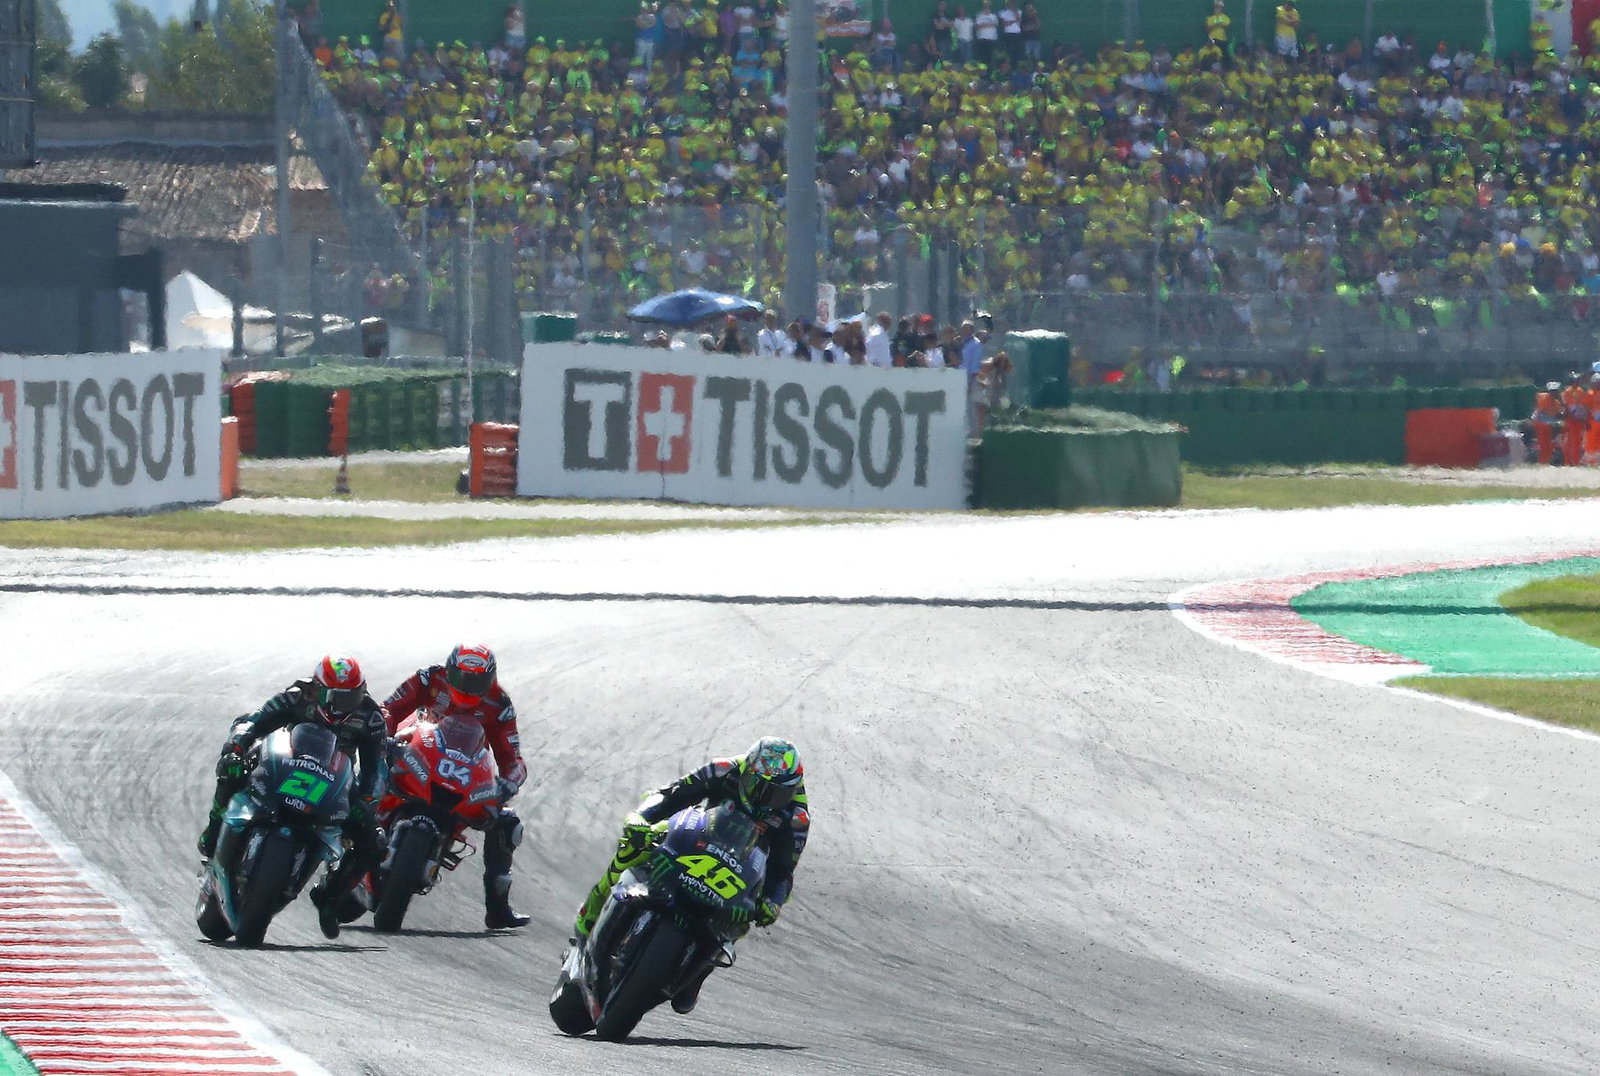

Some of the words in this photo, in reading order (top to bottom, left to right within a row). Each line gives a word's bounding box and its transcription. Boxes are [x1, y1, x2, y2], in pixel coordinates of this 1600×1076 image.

[22, 371, 204, 491] TISSOT
[702, 375, 946, 490] TISSOT
[278, 769, 329, 804] 21
[281, 757, 335, 782] PETRONAS
[438, 759, 471, 787] 04
[706, 843, 744, 874] ENEOS
[675, 854, 747, 900] 46
